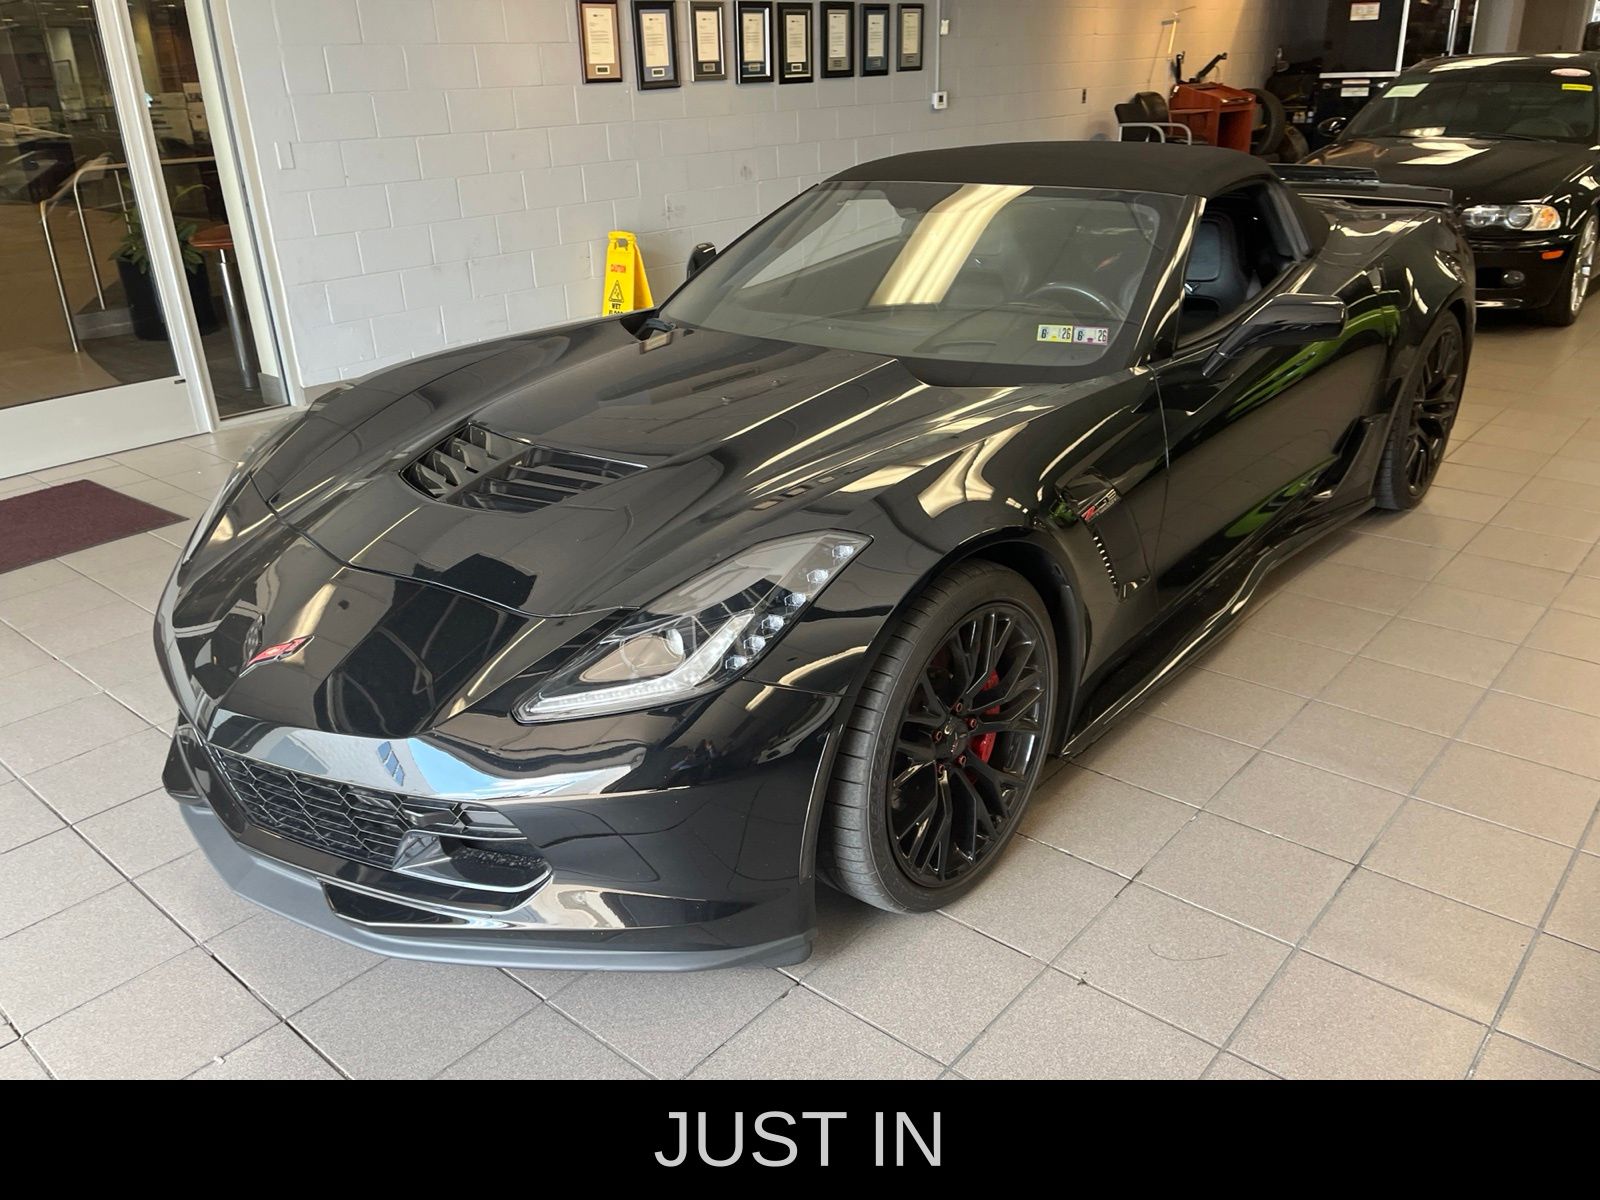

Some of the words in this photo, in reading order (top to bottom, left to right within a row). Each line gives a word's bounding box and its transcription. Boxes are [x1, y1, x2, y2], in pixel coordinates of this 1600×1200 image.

[1041, 328, 1047, 339] 6
[1062, 328, 1071, 340] 26
[1077, 330, 1083, 341] 6
[1098, 330, 1107, 341] 26
